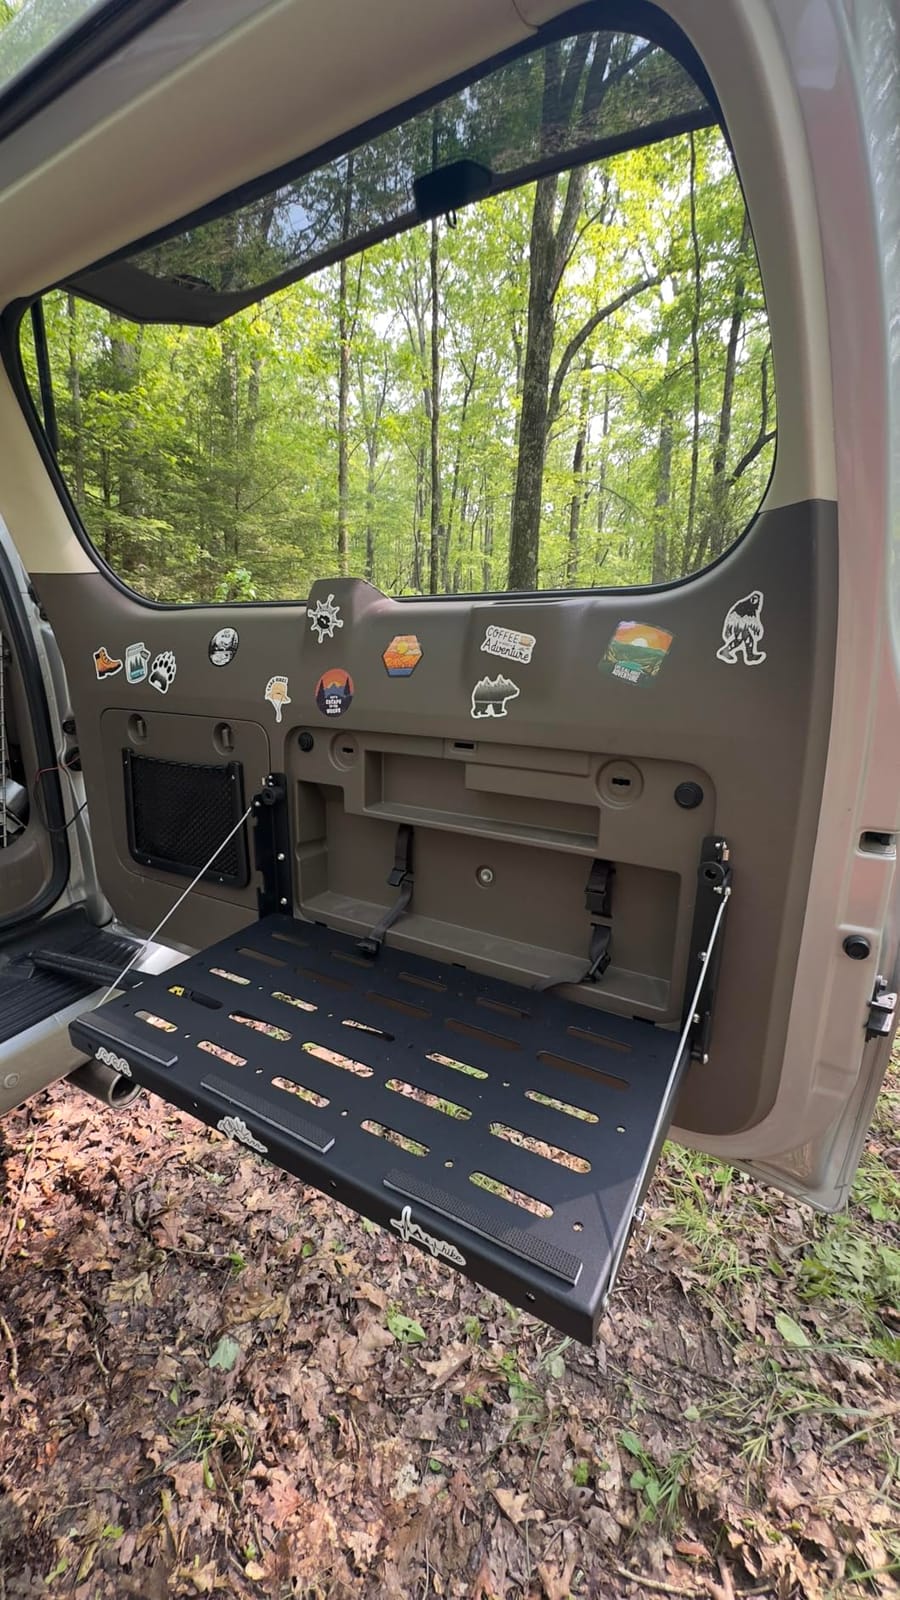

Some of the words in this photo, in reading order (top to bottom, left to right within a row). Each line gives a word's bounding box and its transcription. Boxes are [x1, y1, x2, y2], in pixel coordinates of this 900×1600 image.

[487, 627, 520, 643] COFFEE
[482, 638, 530, 662] Adventure
[441, 1244, 463, 1262] hike
